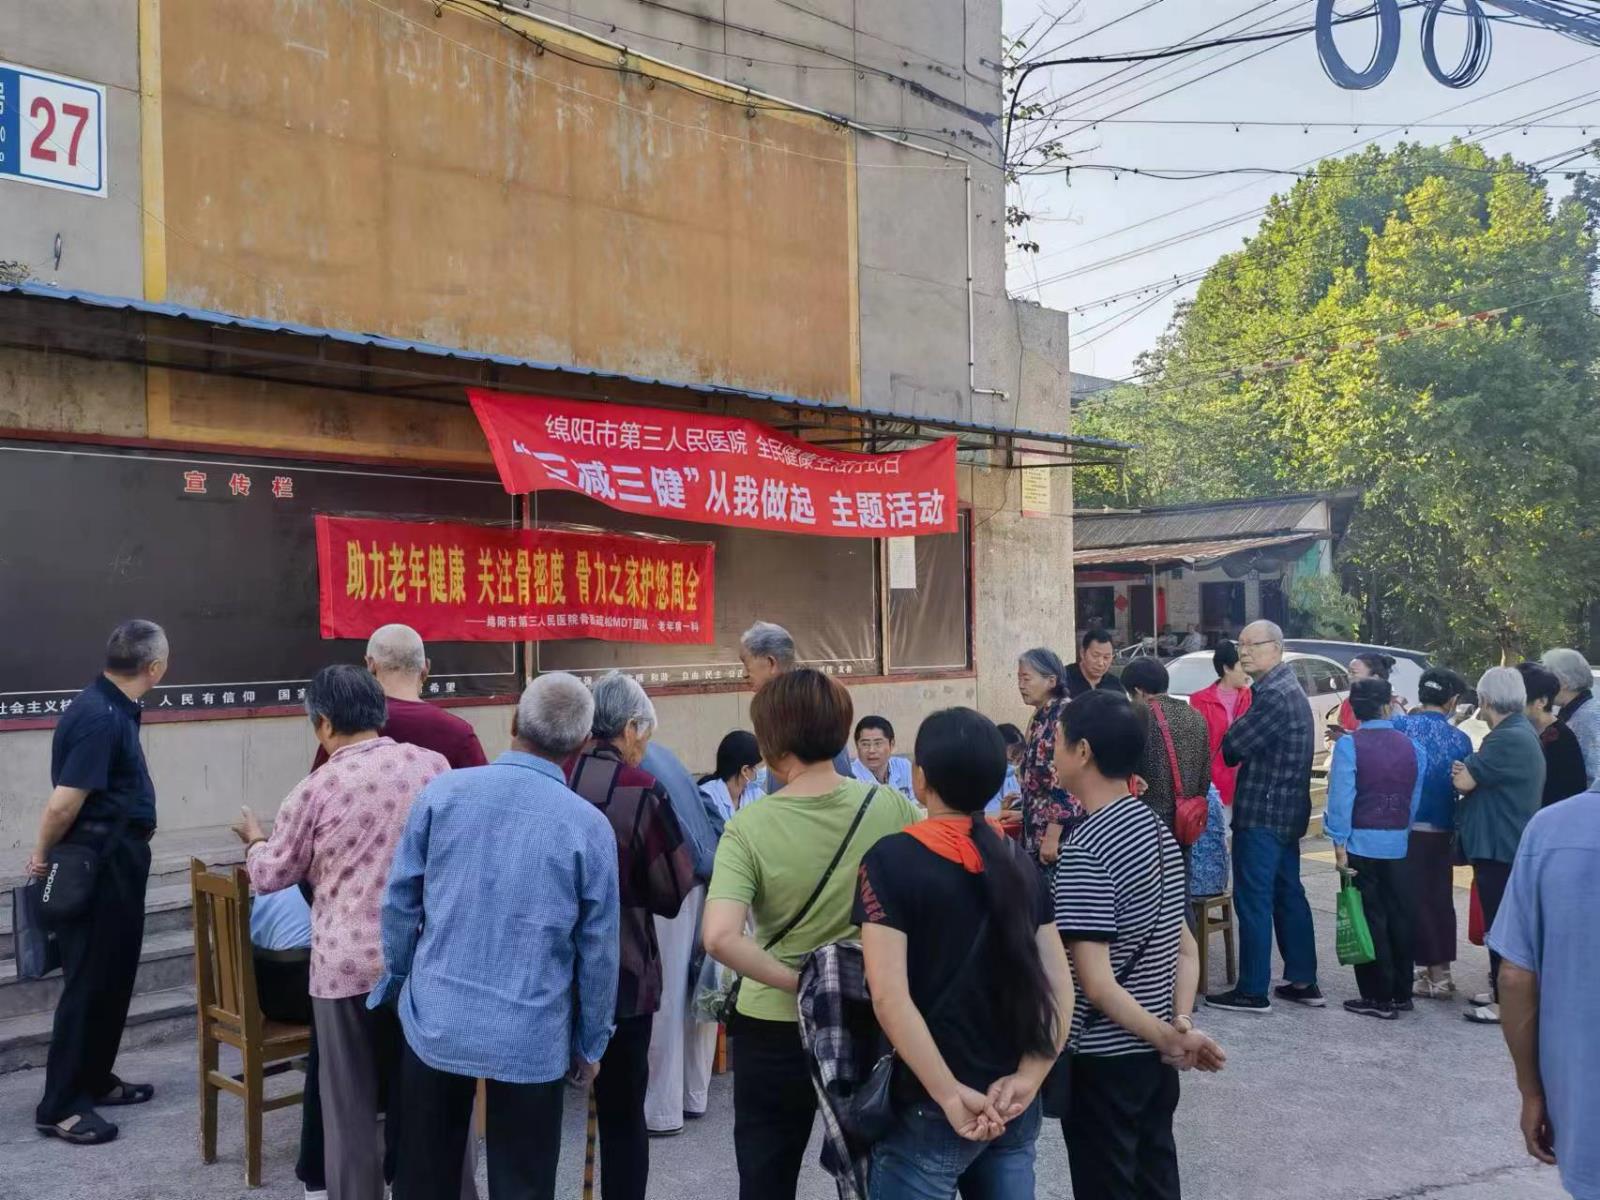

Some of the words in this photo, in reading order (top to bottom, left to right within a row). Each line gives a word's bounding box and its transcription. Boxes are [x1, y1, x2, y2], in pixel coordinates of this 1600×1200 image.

[30, 96, 90, 167] 27
[545, 414, 748, 455] 绵阳市第三人民医院
[184, 470, 294, 498] 宣传栏
[829, 488, 945, 529] 主题活动
[346, 539, 467, 605] 助力老年健康
[477, 546, 567, 606] 关注骨密度
[159, 690, 256, 707] 人民有信仰
